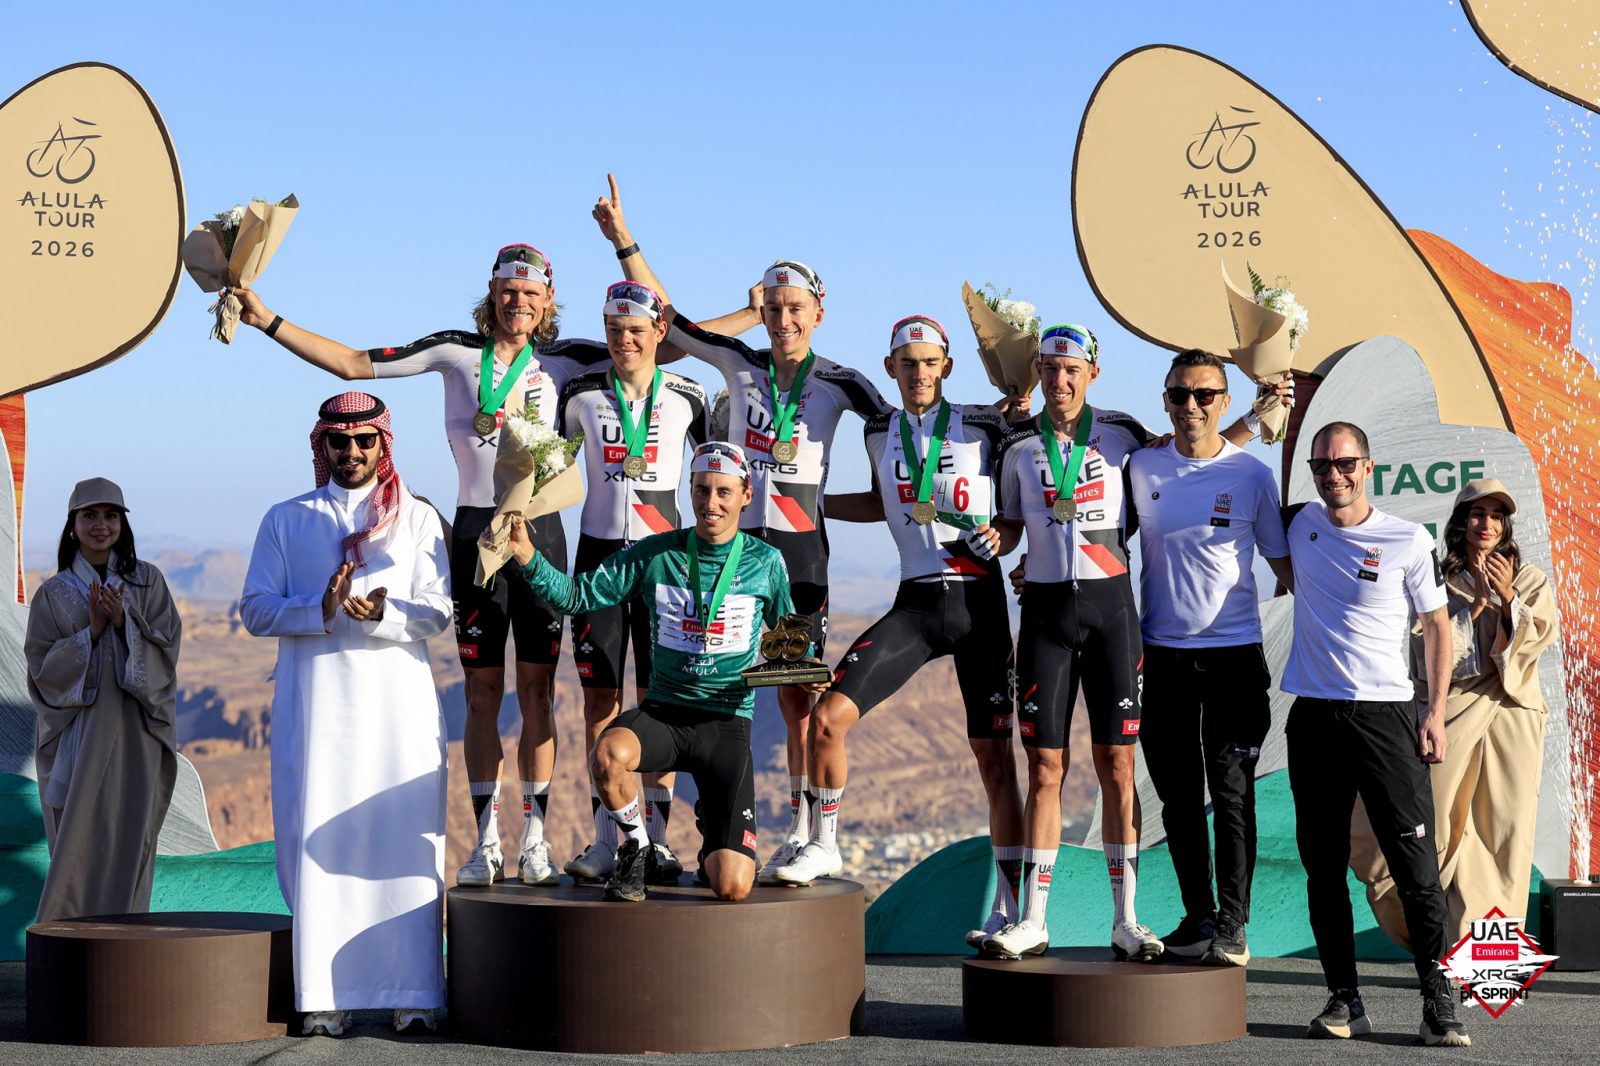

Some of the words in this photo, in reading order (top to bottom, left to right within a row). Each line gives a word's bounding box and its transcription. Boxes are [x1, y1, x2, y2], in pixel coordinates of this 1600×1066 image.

[1179, 181, 1272, 200] ALULA
[16, 191, 109, 209] ALULA
[1198, 201, 1260, 218] TOUR
[34, 211, 95, 228] TOUR
[1197, 231, 1261, 248] 2026
[31, 240, 94, 257] 2026
[674, 383, 703, 398] Analog
[967, 413, 1001, 425] Analog
[1001, 429, 1035, 446] Analog
[1373, 460, 1485, 496] TAGE
[681, 665, 719, 676] ALULA
